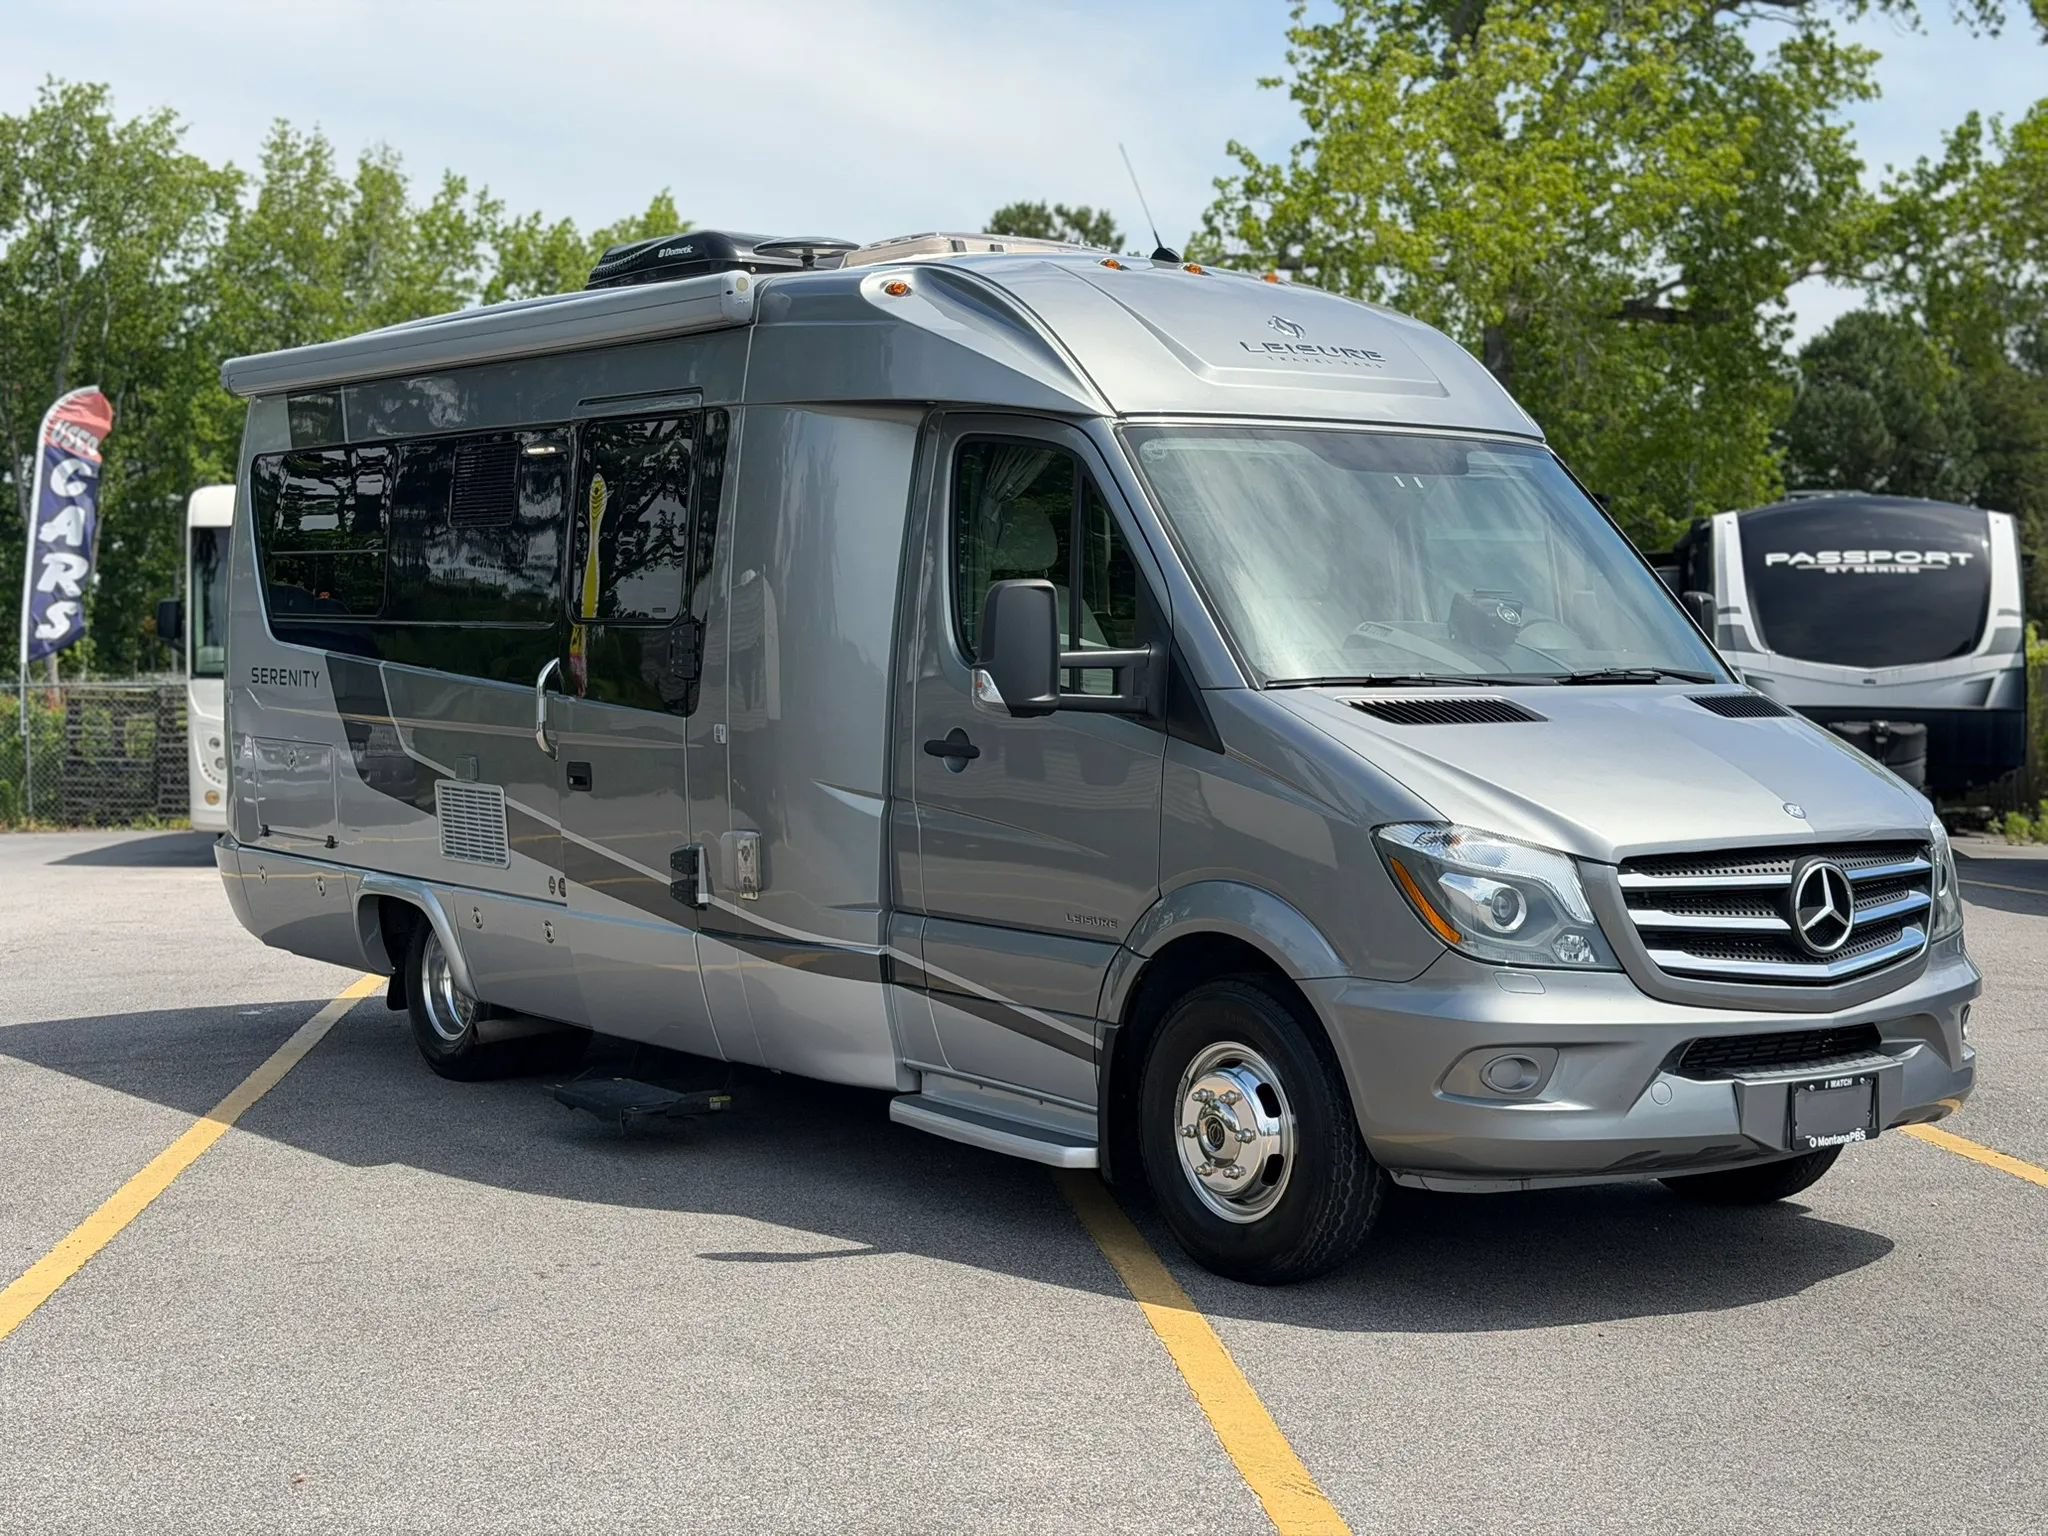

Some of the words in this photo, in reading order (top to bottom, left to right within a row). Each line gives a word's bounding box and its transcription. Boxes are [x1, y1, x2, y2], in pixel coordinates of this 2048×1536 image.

[1239, 341, 1387, 362] LEISURE
[35, 458, 93, 640] CARS
[1765, 551, 1973, 566] PASSPORT
[251, 667, 320, 689] SERENITY
[1064, 912, 1119, 929] LEISURE
[1824, 1080, 1829, 1089] I
[1830, 1078, 1853, 1089] WATCH
[1817, 1130, 1866, 1147] MontanaPBS
